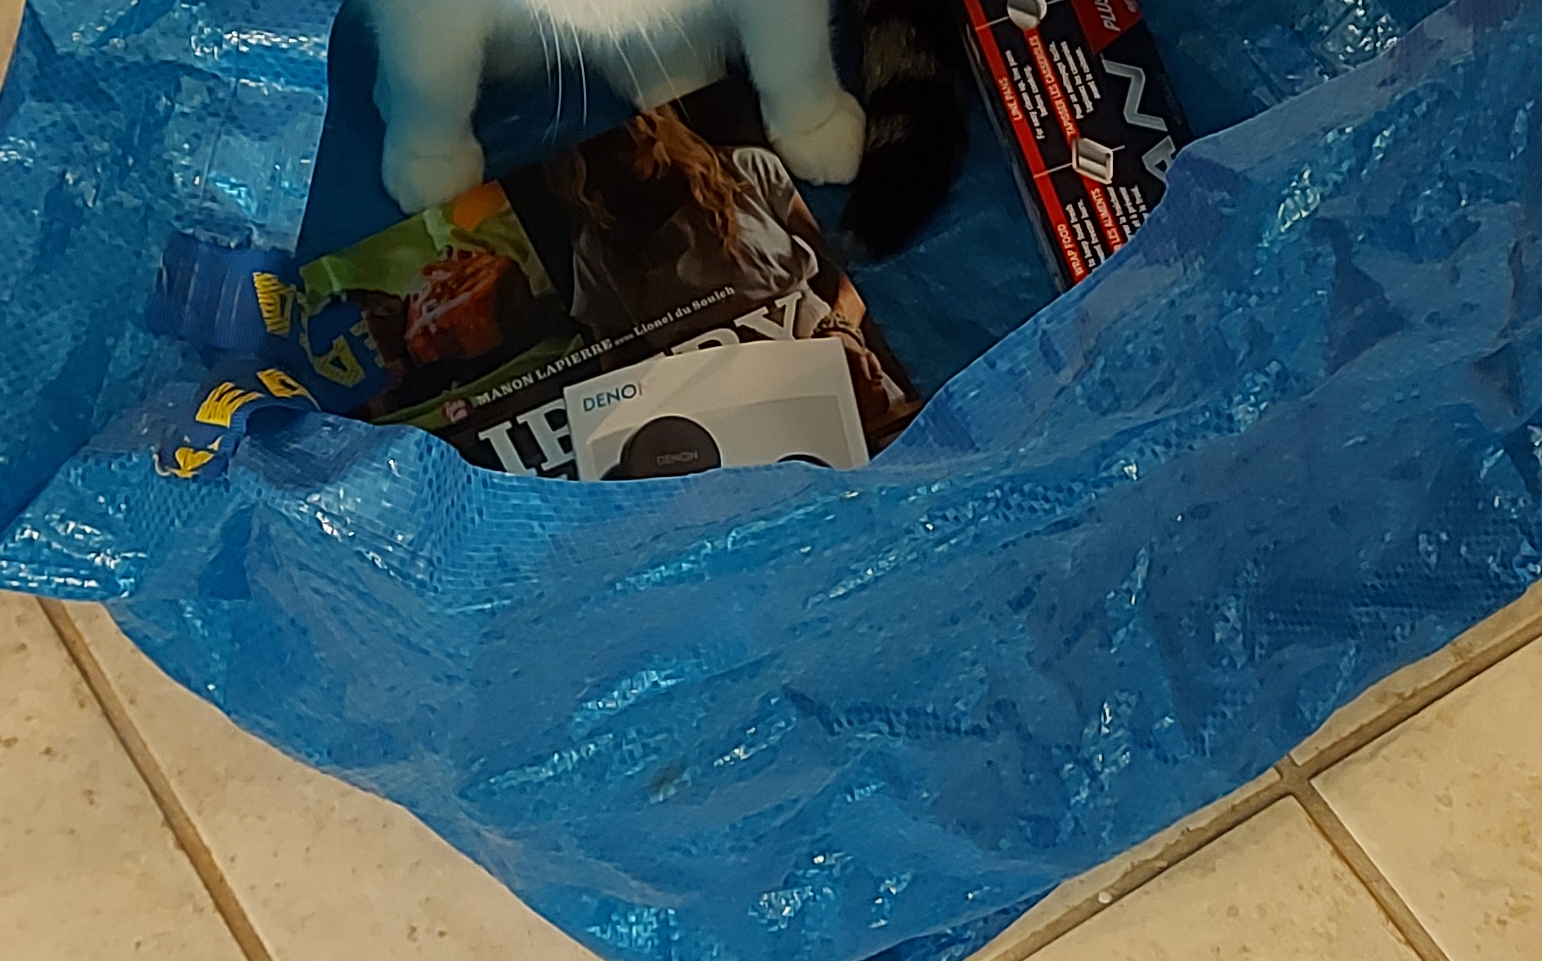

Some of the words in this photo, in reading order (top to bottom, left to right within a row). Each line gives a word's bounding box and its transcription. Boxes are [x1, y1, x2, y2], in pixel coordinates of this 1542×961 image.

[997, 75, 1015, 101] PANS
[1006, 99, 1023, 121] LINE
[1089, 186, 1114, 229] ALIMENTS
[1056, 221, 1074, 249] FOOD
[1105, 226, 1120, 244] LES
[1066, 247, 1084, 276] WRAP
[476, 373, 534, 406] MANON
[535, 338, 613, 380] LAPIERRE
[633, 311, 674, 336] Lionel
[673, 303, 691, 318] du
[691, 284, 736, 311] Souich
[582, 382, 642, 411] DENO
